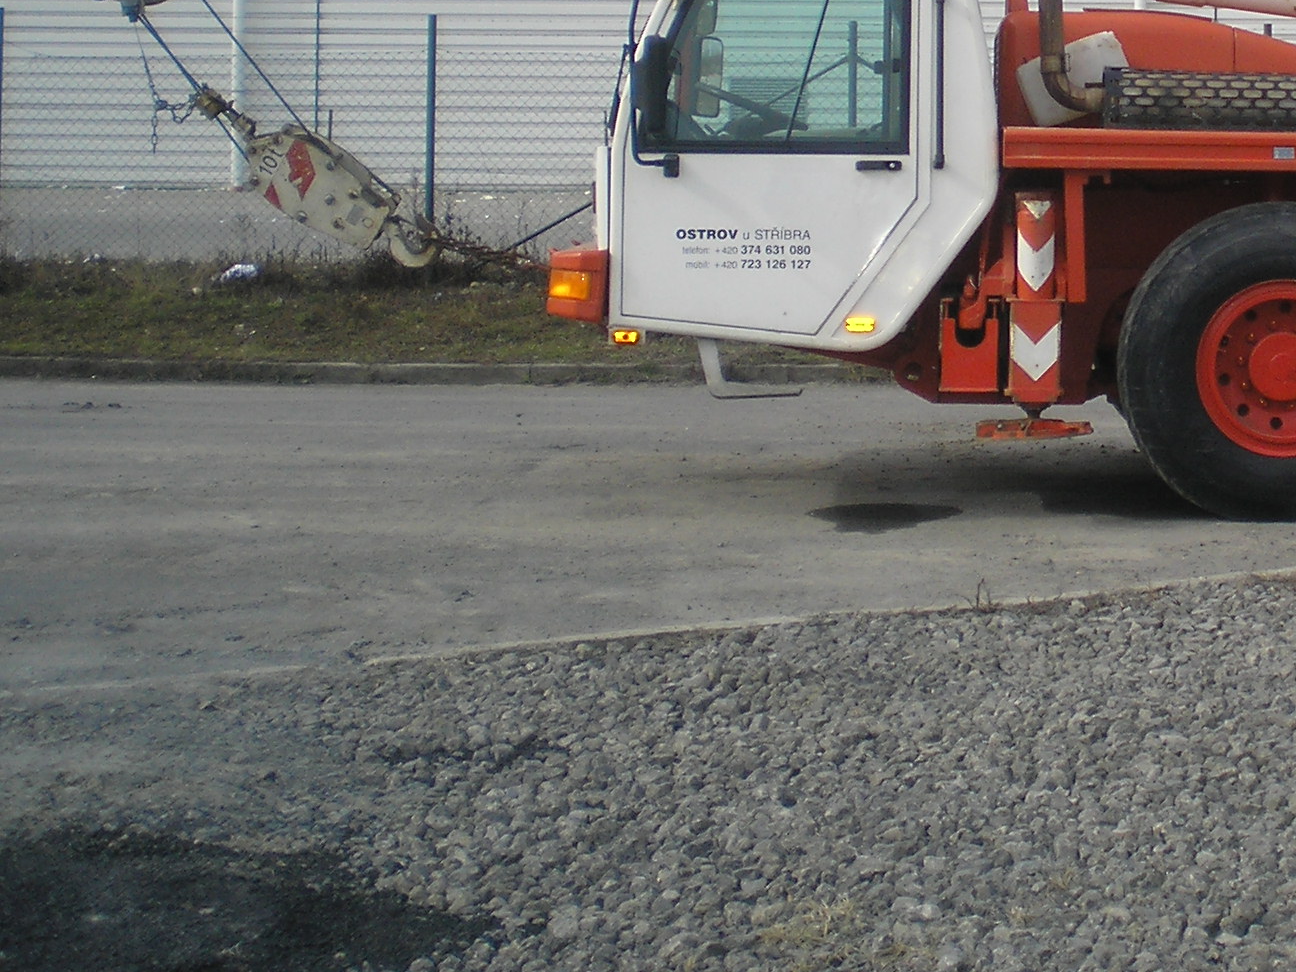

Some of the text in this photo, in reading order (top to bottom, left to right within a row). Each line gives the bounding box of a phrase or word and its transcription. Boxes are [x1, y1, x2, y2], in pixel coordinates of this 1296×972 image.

[676, 226, 811, 241] OSTROV u STŘÍBRA
[740, 244, 761, 255] 374
[765, 244, 785, 255] 631
[789, 244, 811, 255] 080
[740, 259, 761, 269] 723
[766, 259, 787, 269] 126
[791, 259, 811, 269] 127
